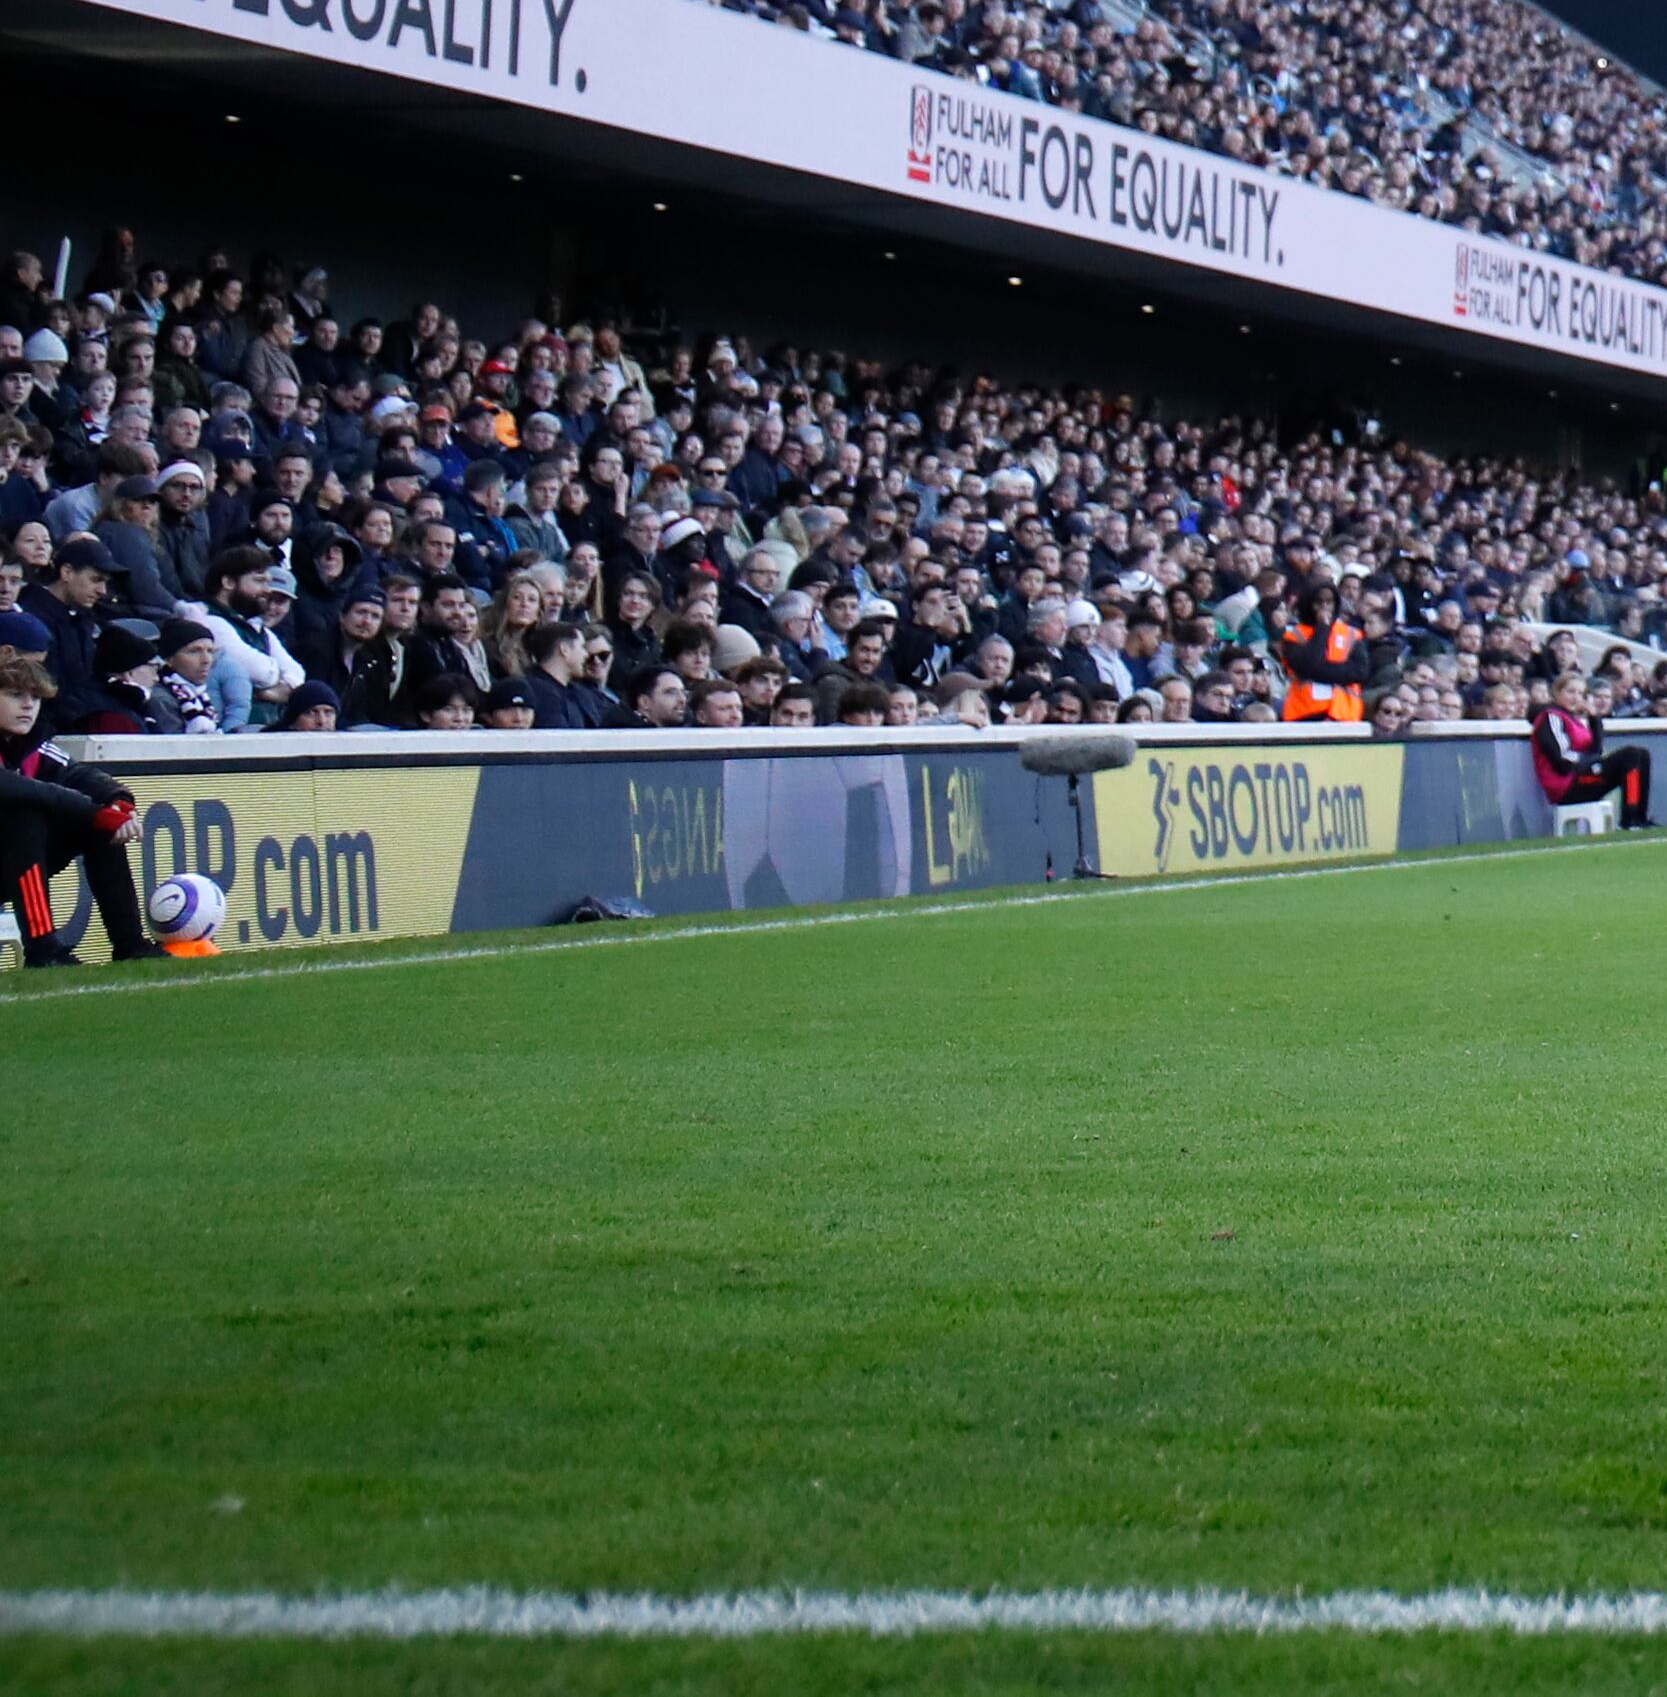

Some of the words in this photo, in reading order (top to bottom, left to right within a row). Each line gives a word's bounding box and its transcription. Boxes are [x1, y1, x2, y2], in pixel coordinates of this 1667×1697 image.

[937, 94, 1012, 150] FULHAM
[936, 146, 974, 190] FOR
[978, 159, 1011, 201] ALL
[1018, 116, 1097, 219] FOR
[1109, 143, 1284, 266] EQUALITY.
[1470, 249, 1514, 284] FULHAM
[1470, 287, 1491, 319] FOR
[1517, 260, 1561, 336] FOR
[1187, 761, 1368, 859] SBOTOP.com
